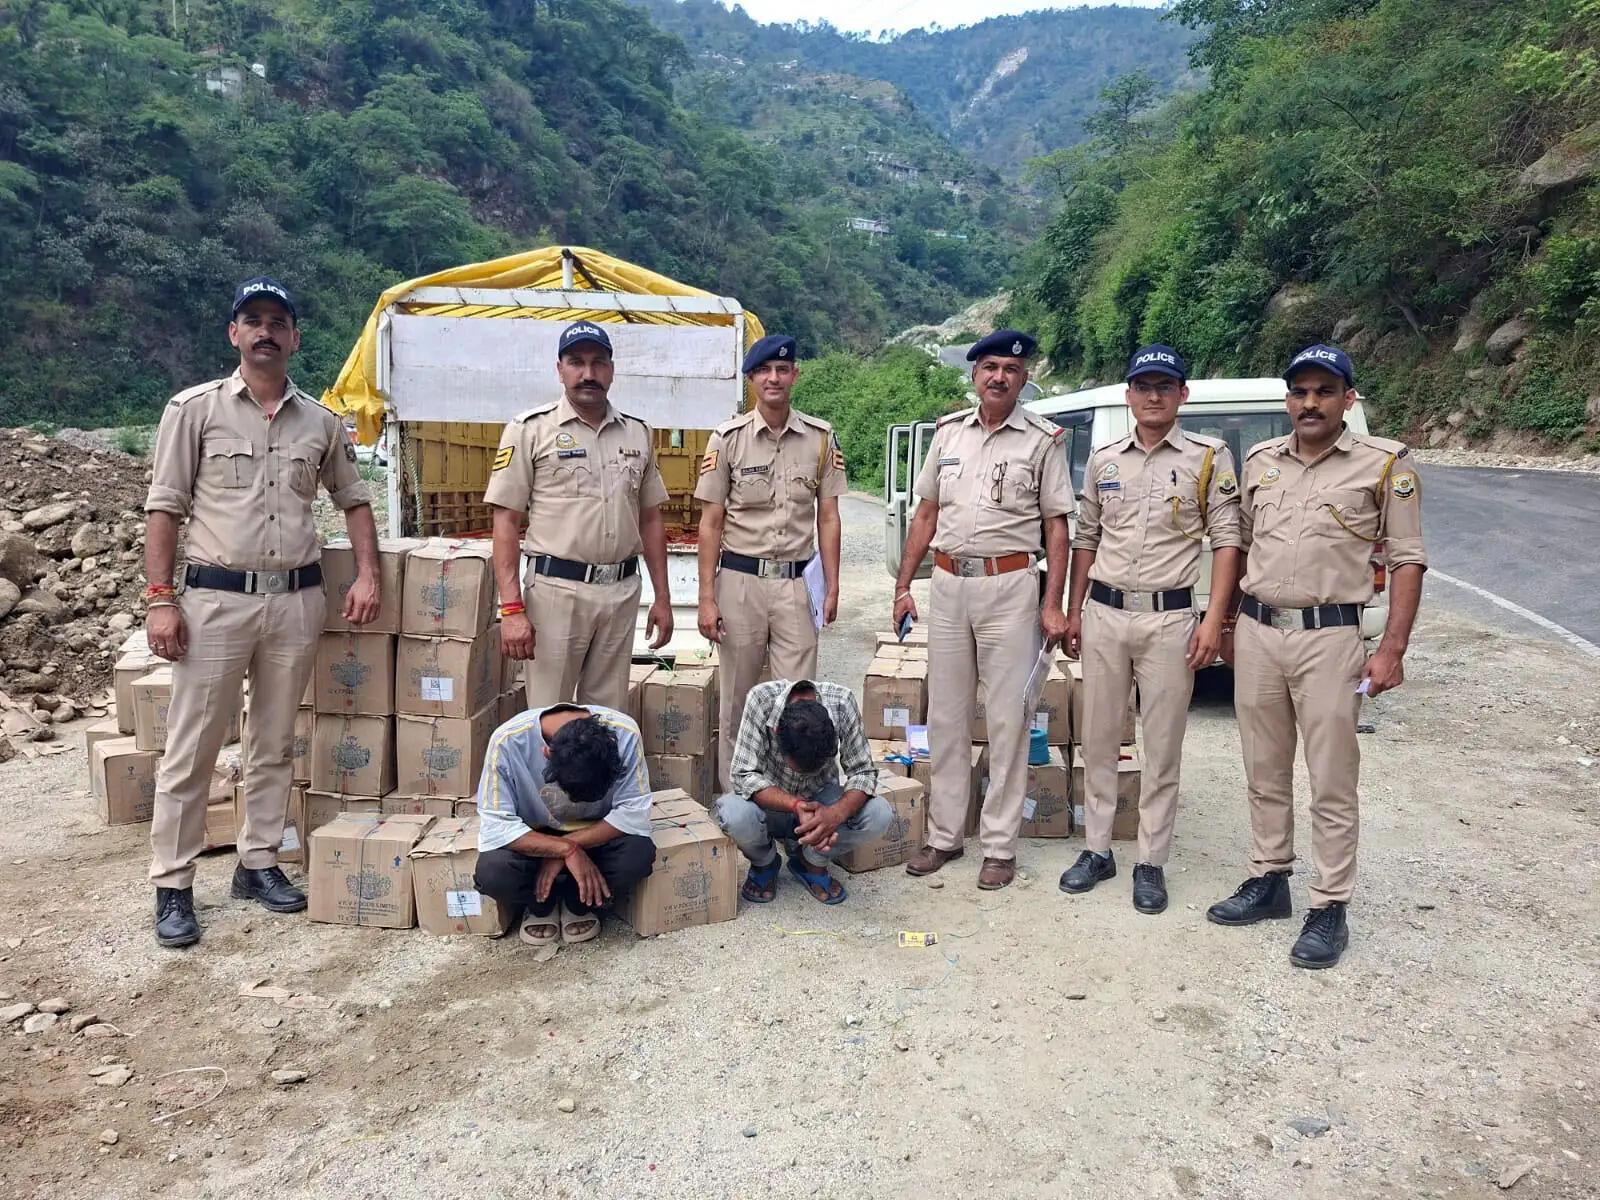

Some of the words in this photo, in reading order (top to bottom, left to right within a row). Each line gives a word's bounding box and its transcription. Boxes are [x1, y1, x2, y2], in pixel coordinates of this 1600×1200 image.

[243, 282, 287, 300] POLICE
[566, 325, 601, 339] POLICE
[1135, 351, 1176, 367] POLICE
[1294, 349, 1338, 364] POLICE
